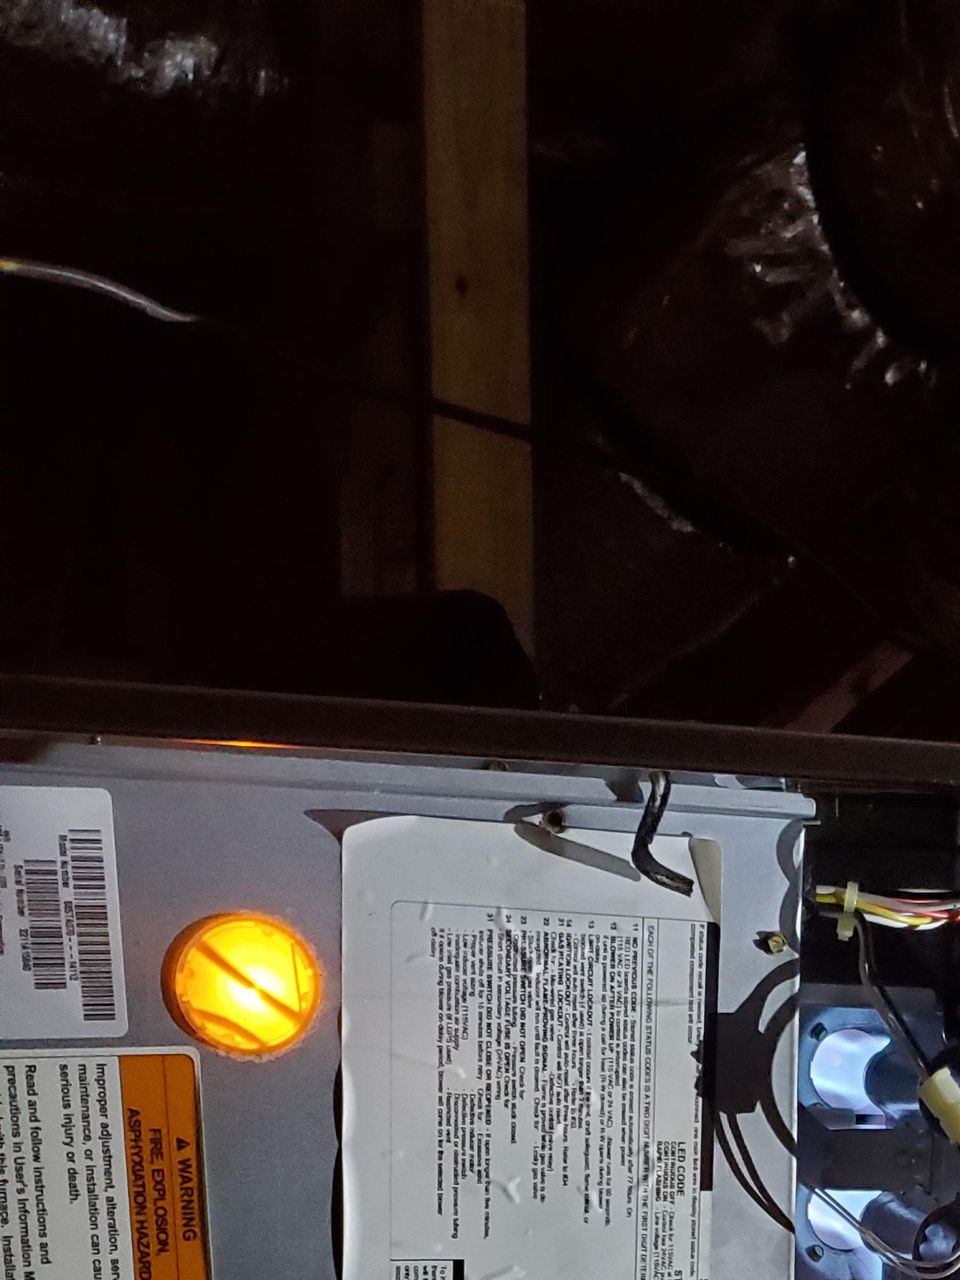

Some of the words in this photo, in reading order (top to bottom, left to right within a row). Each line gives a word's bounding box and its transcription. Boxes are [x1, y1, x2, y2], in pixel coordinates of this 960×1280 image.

[25, 1065, 39, 1096] Read
[59, 1064, 74, 1109] serious
[94, 1063, 111, 1118] Improper
[4, 1066, 24, 1138] precautions
[28, 1099, 41, 1123] and
[75, 1064, 95, 1145] maintenance,
[13, 1141, 25, 1153] in
[30, 1125, 44, 1163] follow
[61, 1113, 77, 1147] injury
[66, 1150, 76, 1163] or
[84, 1148, 93, 1161] or
[98, 1121, 116, 1192] adjustment,
[127, 1108, 147, 1216] ASPHYXIATION
[677, 1141, 686, 1162] LED
[14, 1155, 28, 1195] User's
[67, 1167, 81, 1204] death.
[677, 1165, 685, 1197] CODE
[33, 1166, 50, 1238] instructions
[85, 1164, 101, 1230] installation
[149, 1168, 169, 1256] EXPLOSION,
[177, 1158, 196, 1242] WARNING
[17, 1197, 34, 1267] Information
[90, 1233, 100, 1255] can
[103, 1195, 121, 1255] alteration,
[39, 1241, 52, 1265] and
[135, 1219, 152, 1280] HAZARD
